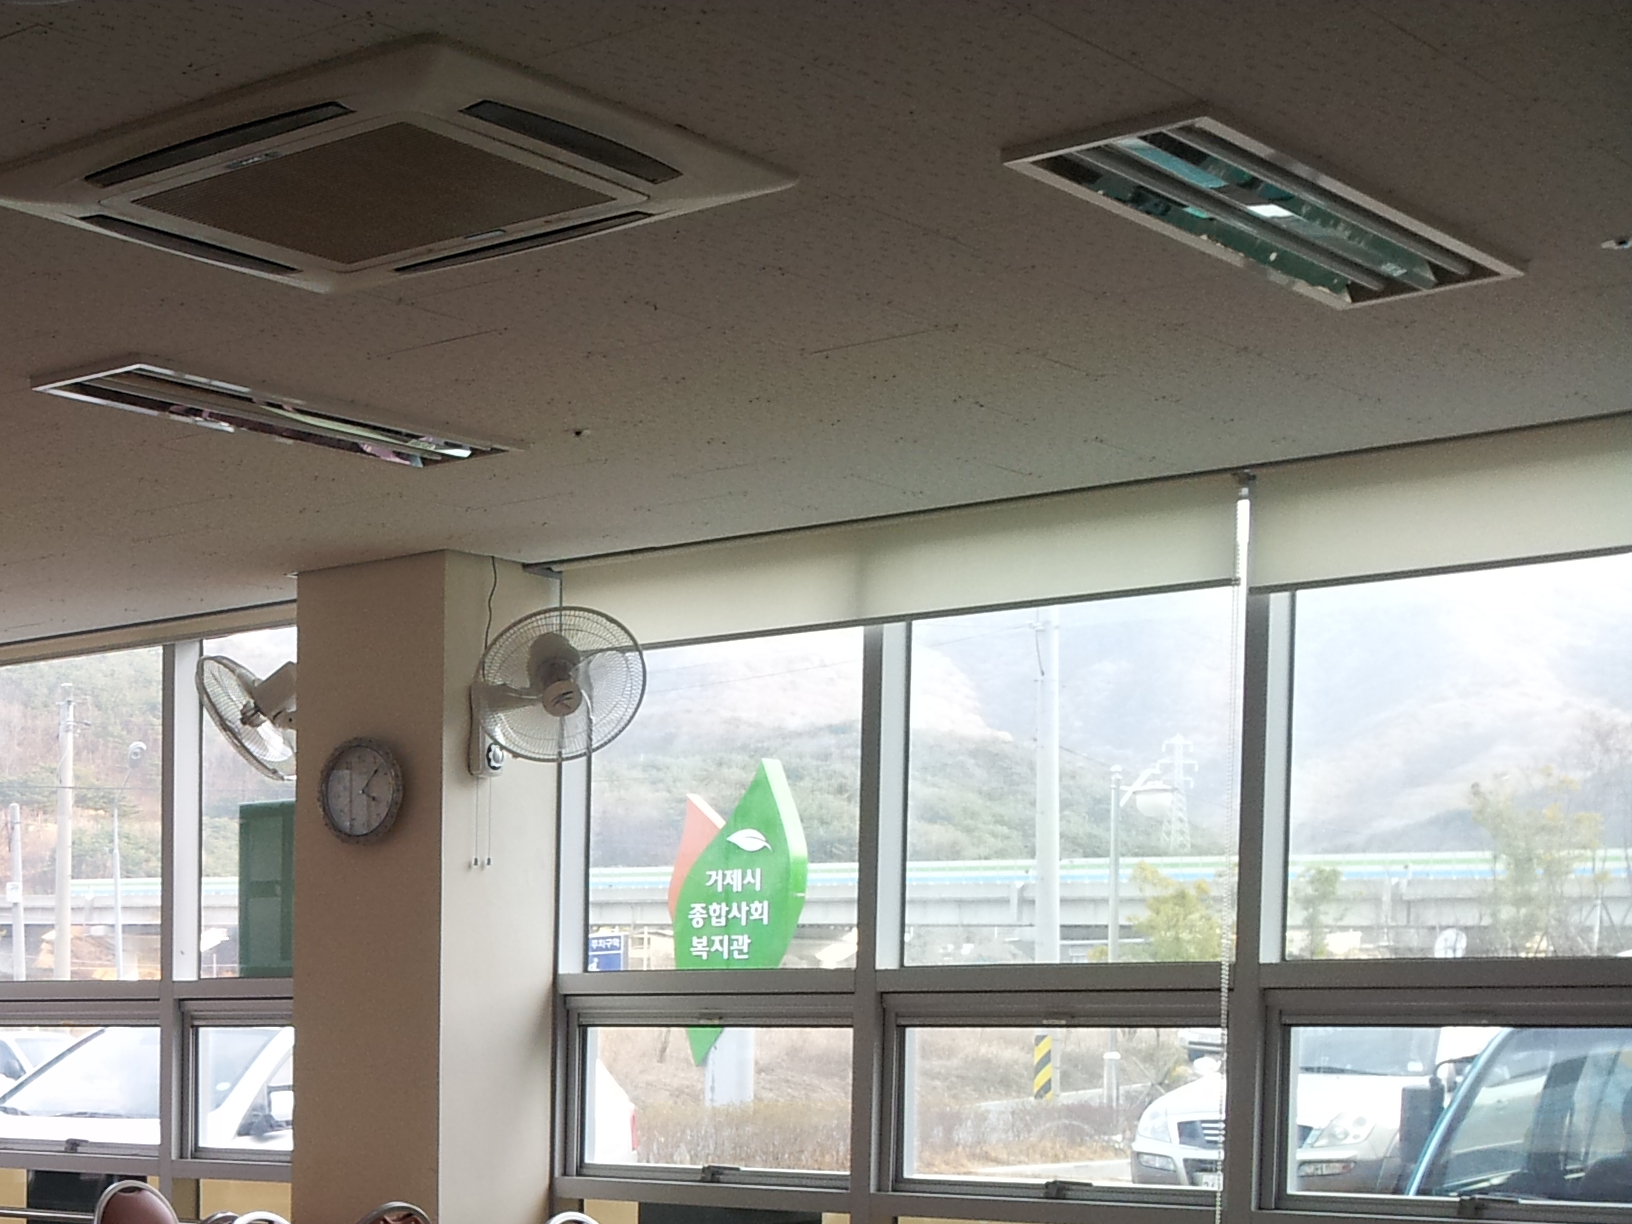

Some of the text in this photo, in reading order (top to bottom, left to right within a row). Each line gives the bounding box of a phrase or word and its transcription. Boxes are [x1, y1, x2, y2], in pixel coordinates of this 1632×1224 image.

[706, 868, 761, 892] 거제시
[688, 901, 769, 928] 종합사회
[690, 935, 752, 960] 복지관
